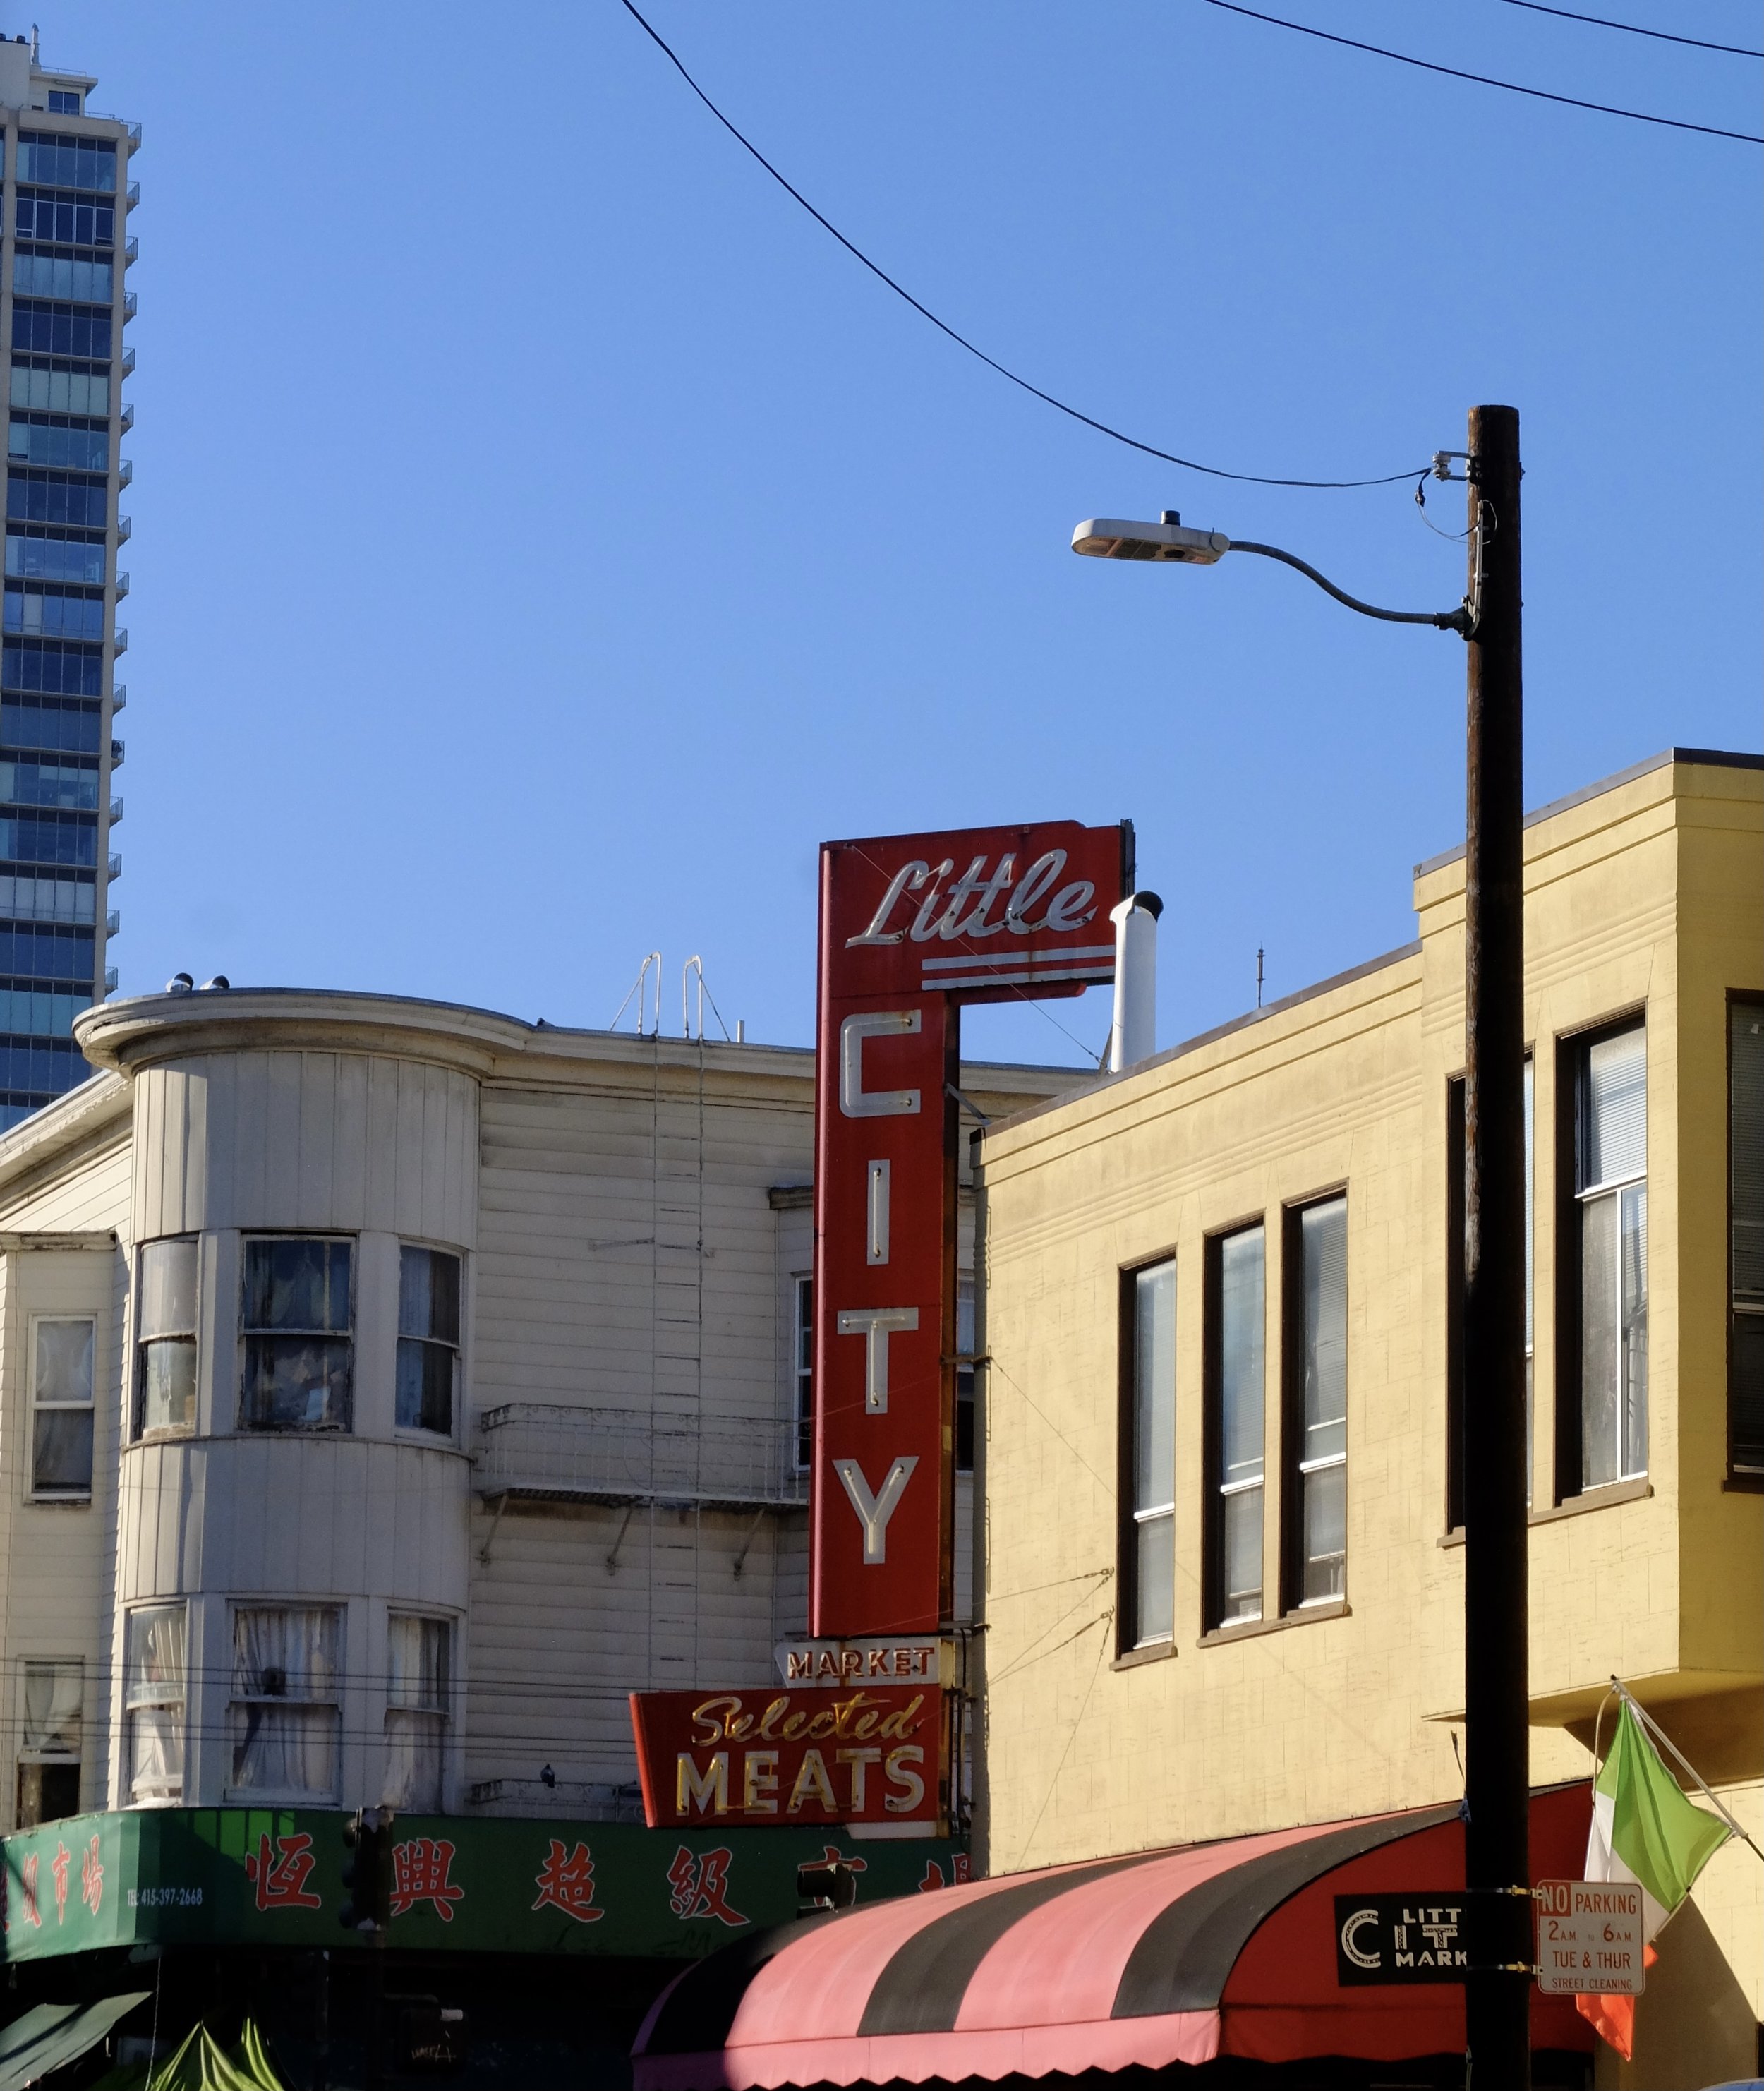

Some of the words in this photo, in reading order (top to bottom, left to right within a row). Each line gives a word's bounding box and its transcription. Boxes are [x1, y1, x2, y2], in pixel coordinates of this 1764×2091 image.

[845, 848, 1098, 948] Little
[831, 1008, 922, 1565] CITY
[787, 1646, 935, 1680] MARKET
[691, 1692, 924, 1747] Selected
[676, 1744, 926, 1816] MEATS
[0, 1833, 104, 1935] 級市場
[141, 1887, 203, 1906] 415-397-2668
[1542, 1885, 1568, 1913] NO
[1576, 1893, 1637, 1915] PARKING
[1553, 1951, 1576, 1968] TUE
[1582, 1951, 1592, 1968] &
[1596, 1952, 1631, 1970] THUR
[1552, 1978, 1585, 1989] STREET
[1589, 1979, 1633, 1990] CLEANING
